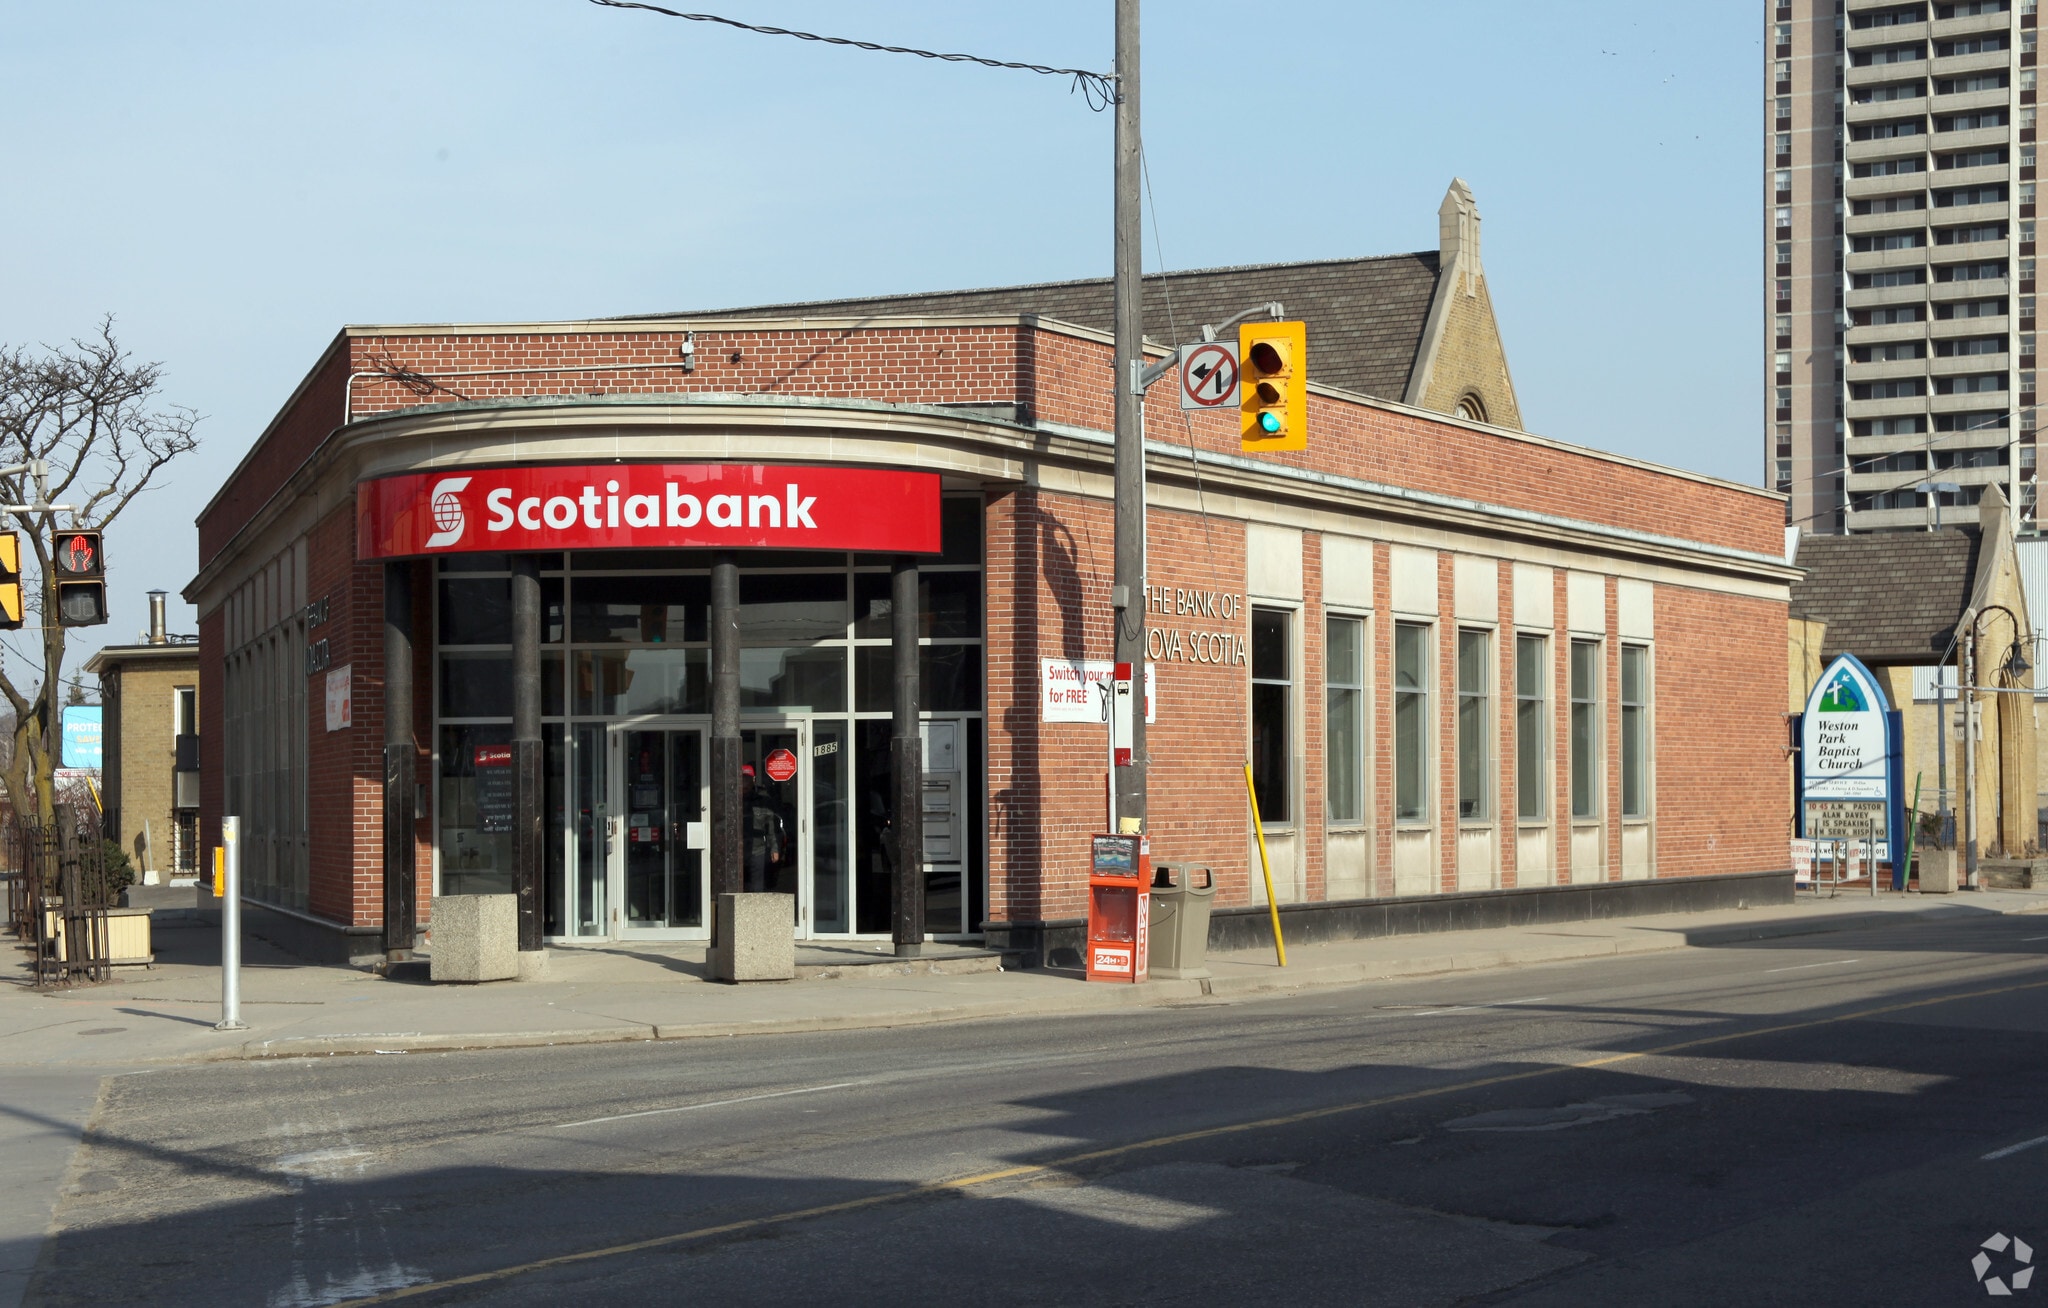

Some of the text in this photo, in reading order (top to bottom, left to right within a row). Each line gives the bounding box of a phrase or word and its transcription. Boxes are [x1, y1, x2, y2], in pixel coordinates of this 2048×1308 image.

[486, 480, 818, 531] Scotiabank
[1176, 588, 1217, 618] BANK
[1220, 592, 1241, 620] OF
[1189, 630, 1247, 666] SCOTIA
[1049, 665, 1080, 681] Switch
[1083, 670, 1104, 685] your
[1049, 688, 1063, 703] for
[1818, 720, 1859, 731] Weston
[1818, 733, 1846, 744] Park
[816, 743, 837, 755] 1885
[1818, 745, 1861, 759] Baptist
[1818, 758, 1863, 770] Church
[1830, 803, 1846, 811] A.M.
[1853, 803, 1881, 811] PASTOR
[1828, 828, 1849, 836] SERV.
